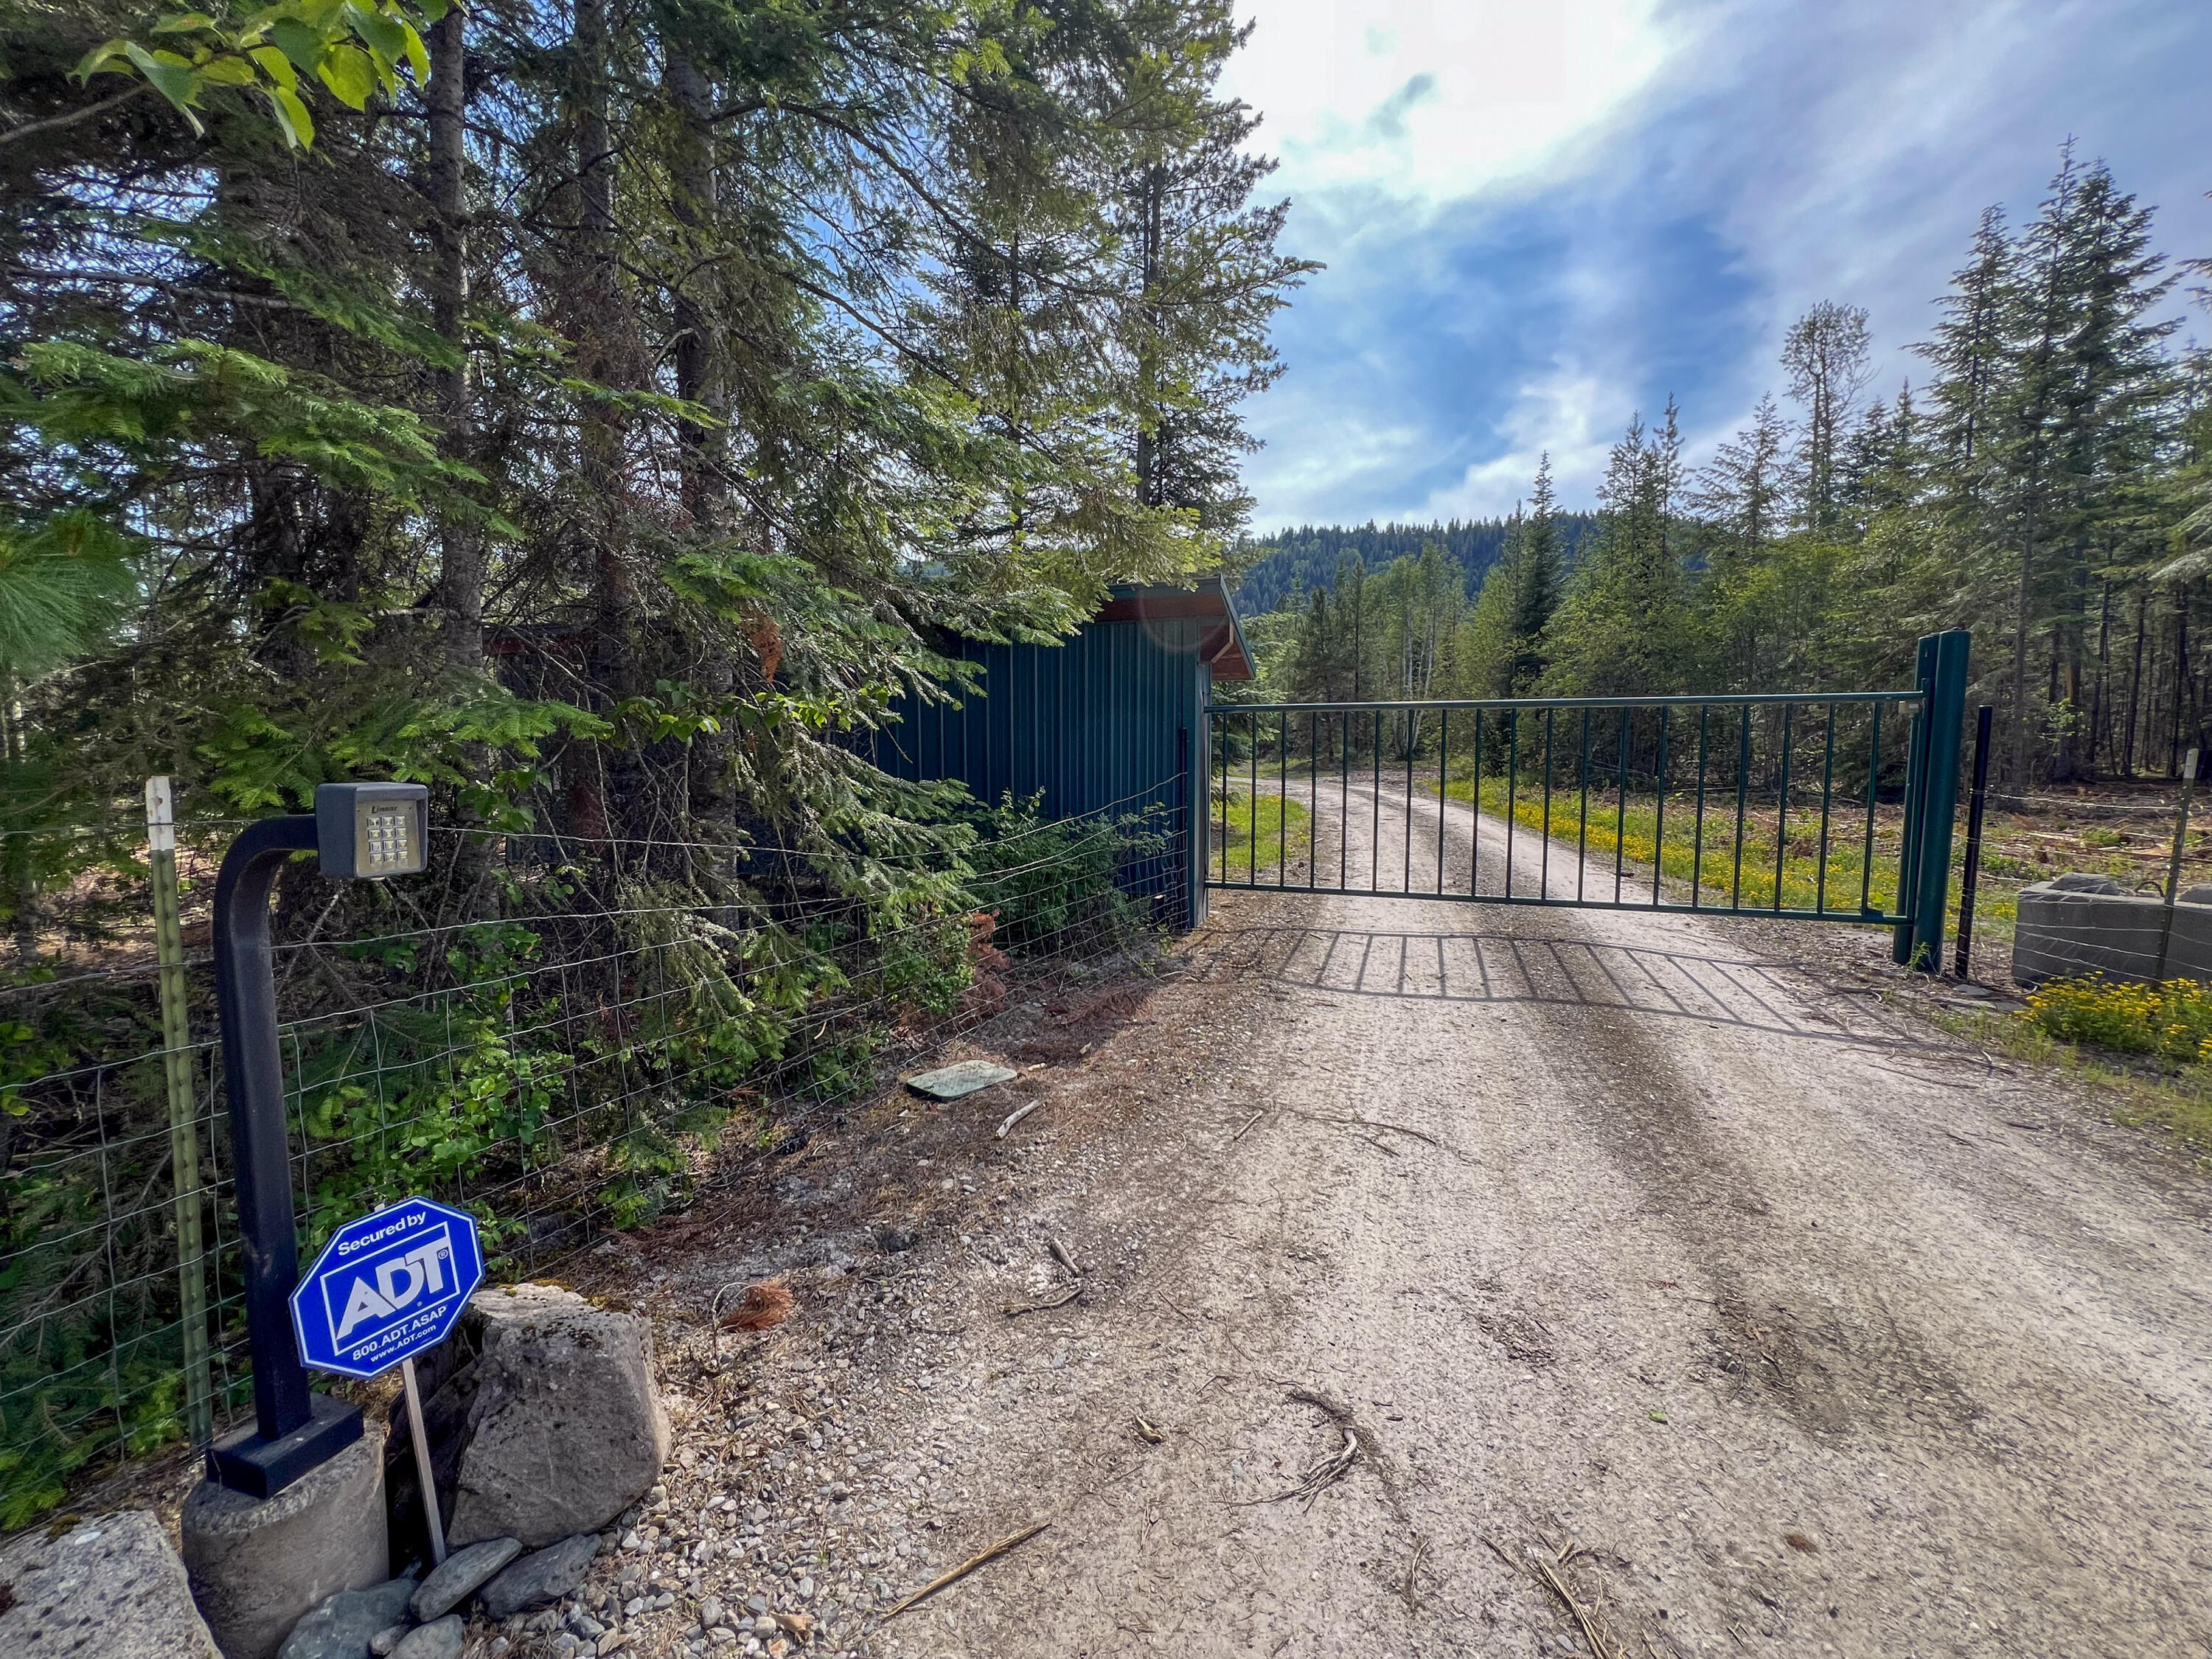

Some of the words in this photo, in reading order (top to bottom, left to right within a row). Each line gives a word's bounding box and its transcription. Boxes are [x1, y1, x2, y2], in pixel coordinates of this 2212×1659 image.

[338, 1217, 406, 1256] Secured
[407, 1211, 426, 1226] by
[352, 1306, 447, 1361] 800.ADT.ASAP
[370, 1324, 437, 1363] www.ADT.com
